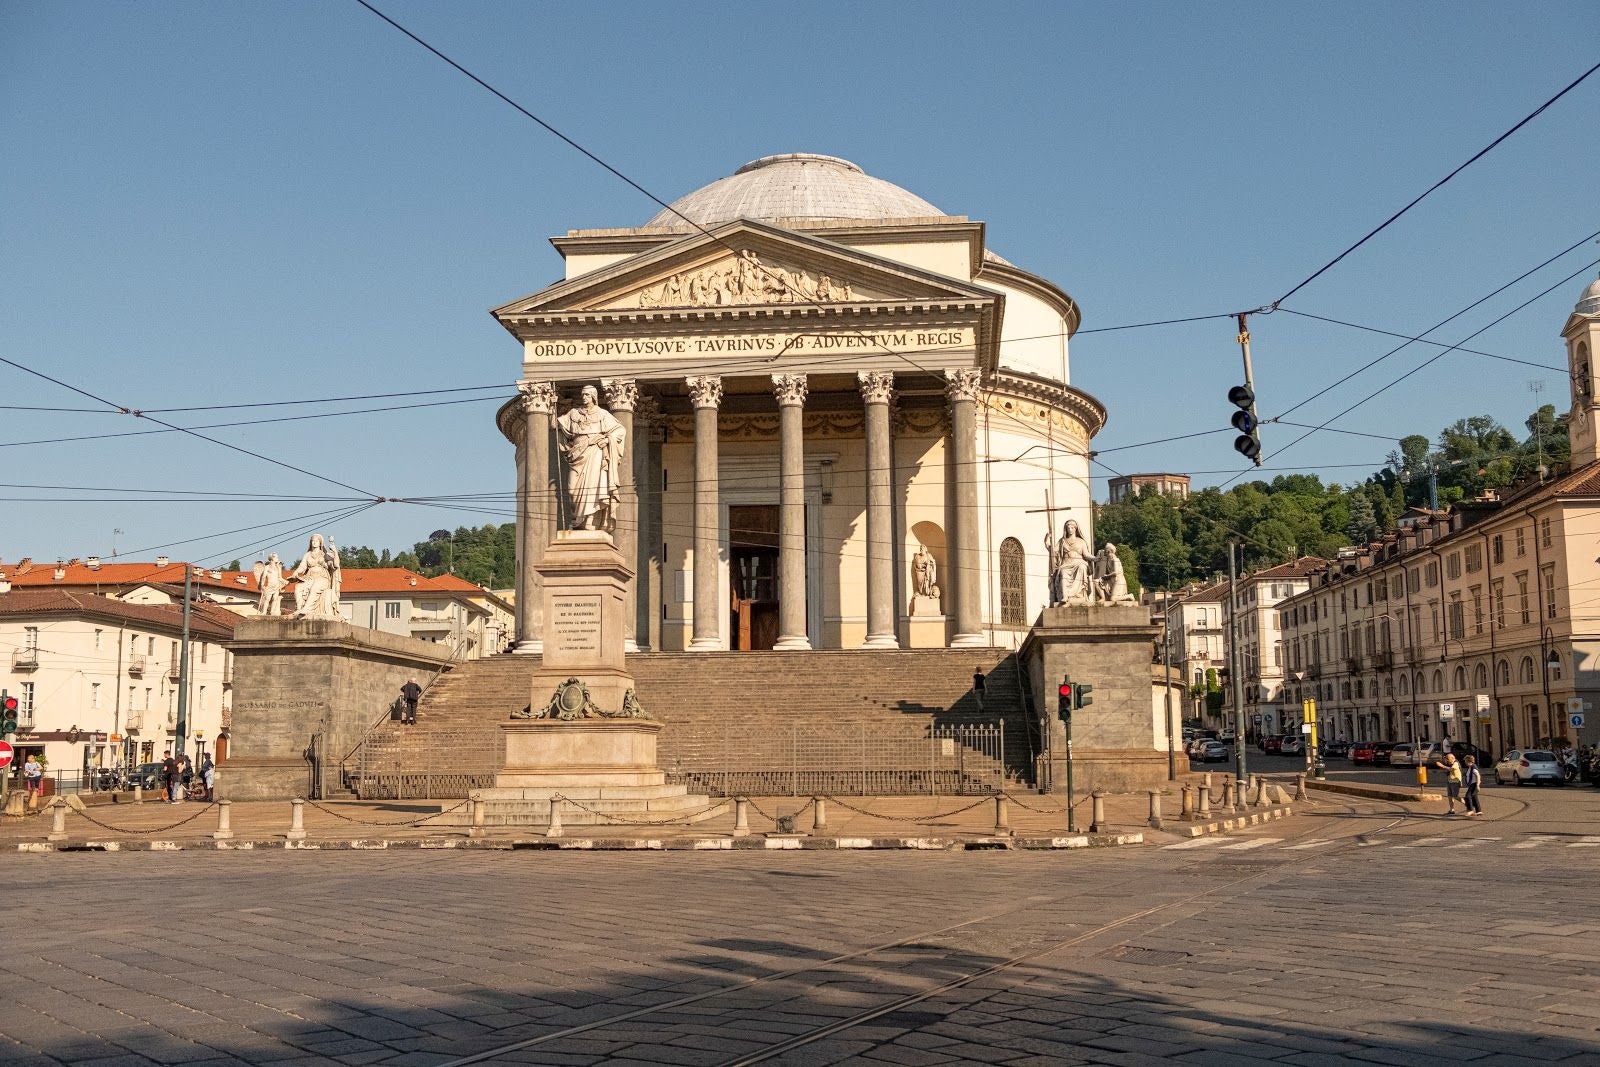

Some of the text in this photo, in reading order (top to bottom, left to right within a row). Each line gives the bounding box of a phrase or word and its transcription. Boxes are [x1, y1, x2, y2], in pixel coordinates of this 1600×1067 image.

[534, 332, 962, 357] ORDO POPVLVSQVE TAVRINVS OB ADVENTVM REGIS
